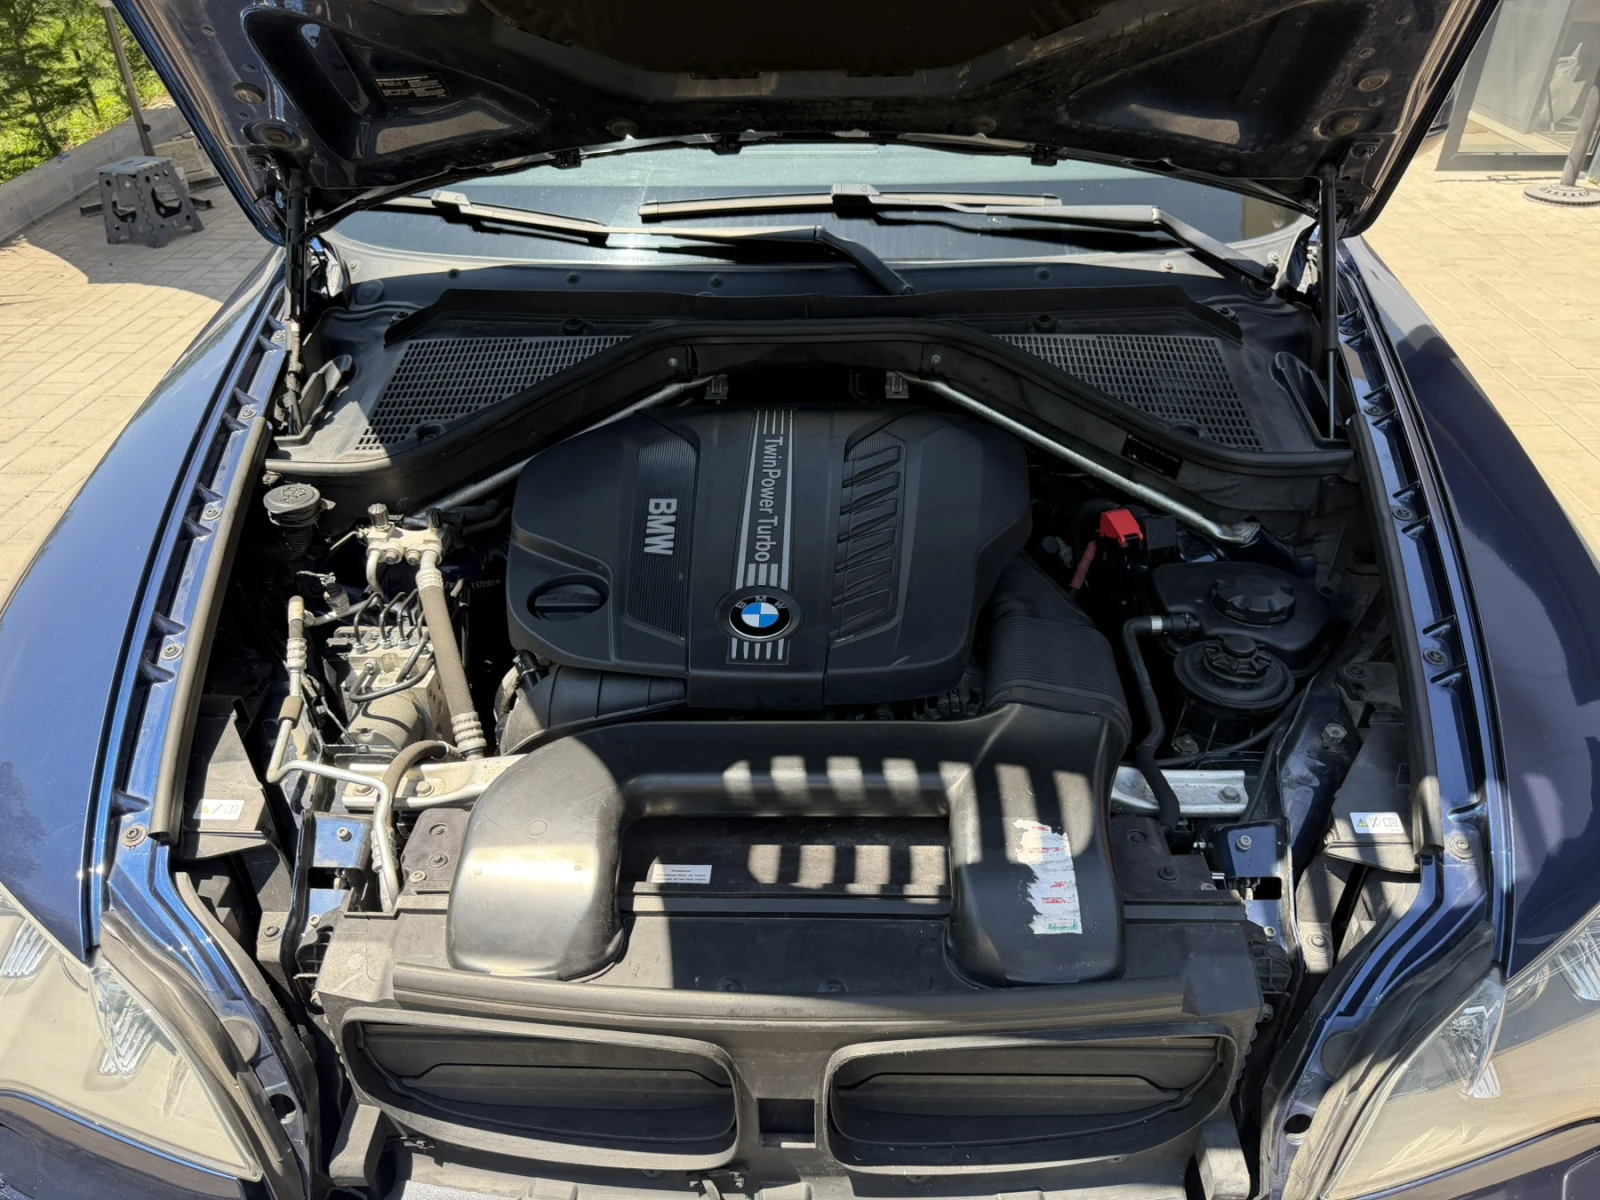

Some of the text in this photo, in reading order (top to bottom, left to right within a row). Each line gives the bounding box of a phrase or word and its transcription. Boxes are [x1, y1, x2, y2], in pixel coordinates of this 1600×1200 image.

[644, 498, 678, 555] BMW
[755, 436, 783, 562] TwinPower Turbo
[735, 595, 787, 609] BMW
